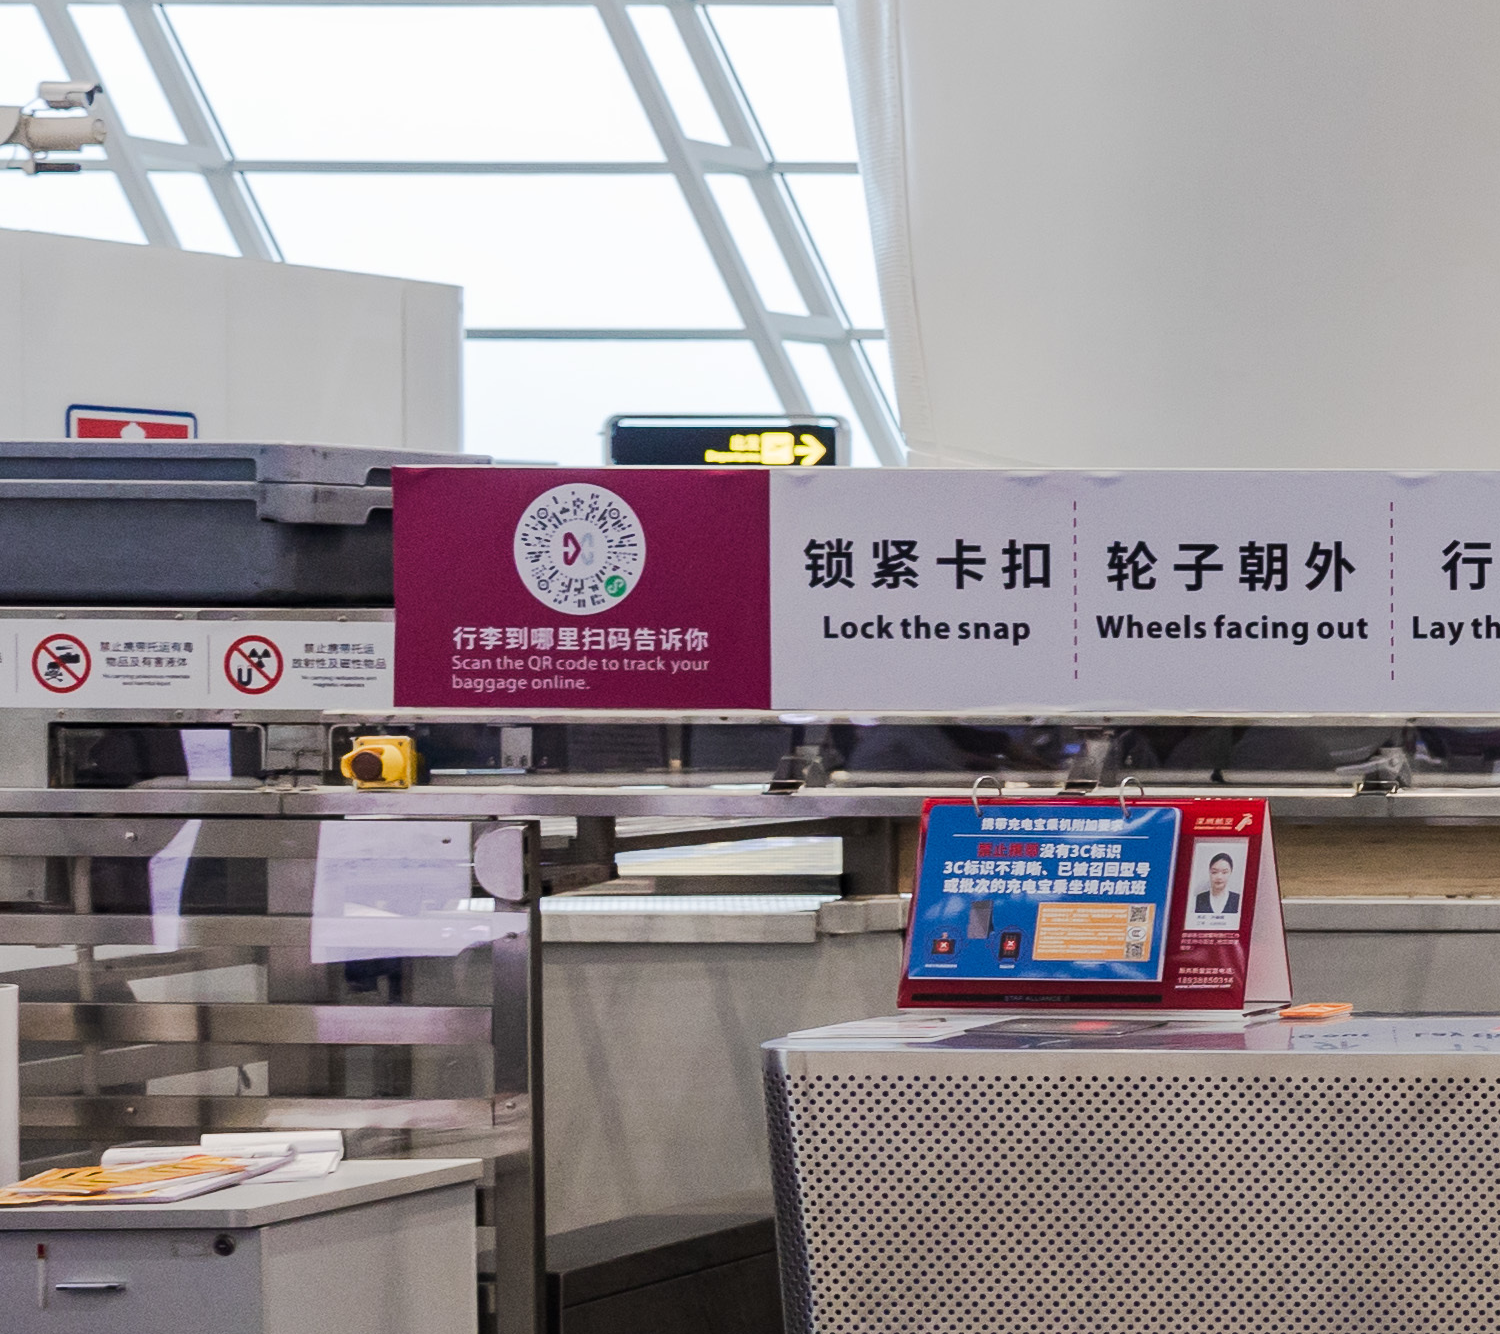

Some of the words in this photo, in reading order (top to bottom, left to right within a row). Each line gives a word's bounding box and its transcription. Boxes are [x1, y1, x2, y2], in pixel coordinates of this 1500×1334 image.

[804, 538, 1050, 589] 锁紧卡扣
[1107, 541, 1355, 591] 轮子朝外
[453, 627, 708, 651] 行李到哪里扫码告诉你
[824, 615, 893, 639] Lock
[901, 615, 950, 639] the
[958, 623, 1030, 645] snap
[1096, 615, 1206, 638] Wheels
[1214, 615, 1308, 645] facing
[1317, 618, 1368, 639] out
[1413, 616, 1464, 645] Lay
[452, 656, 491, 670] Scan
[496, 656, 524, 670] the
[528, 656, 552, 671] QR
[555, 656, 598, 670] code
[601, 658, 620, 671] to
[623, 656, 665, 670] track
[671, 660, 709, 674] your
[452, 674, 528, 692] baggage
[531, 675, 590, 689] online.
